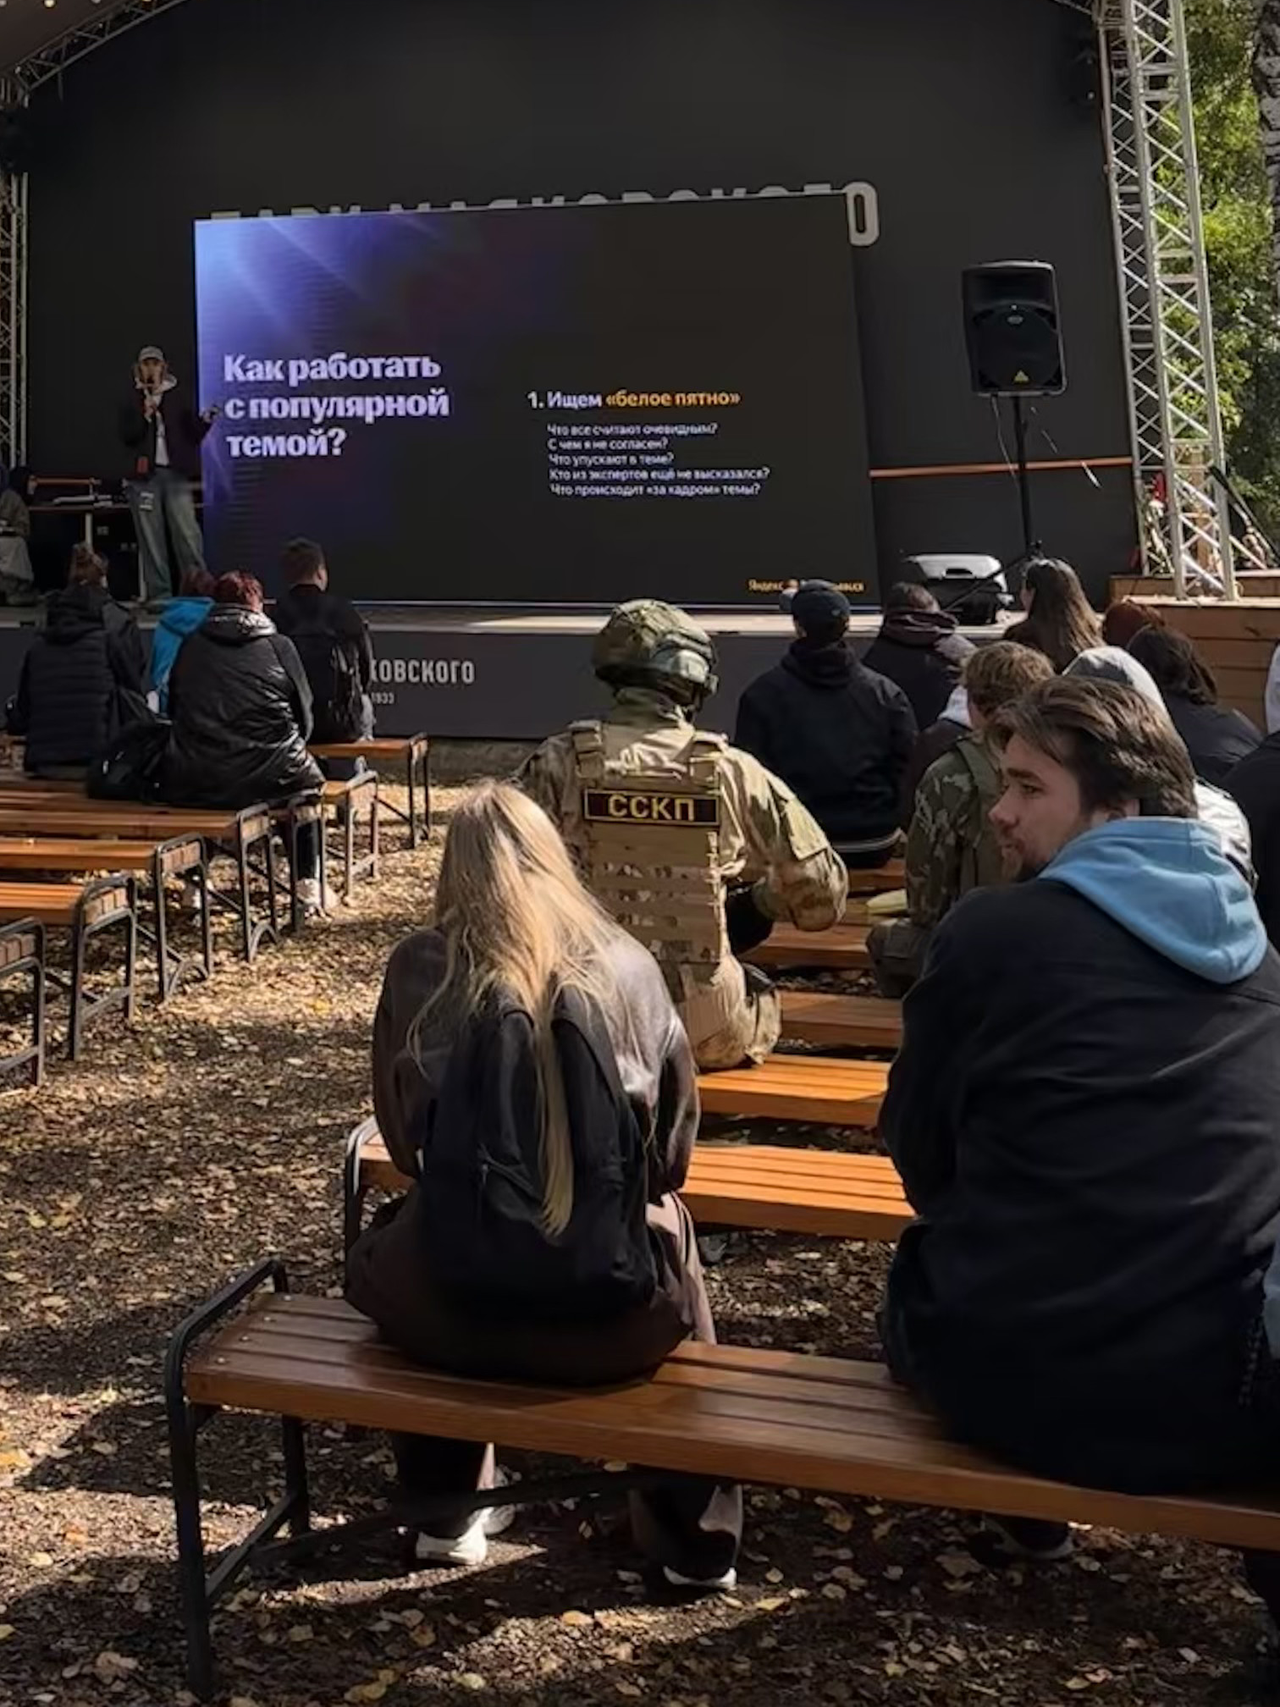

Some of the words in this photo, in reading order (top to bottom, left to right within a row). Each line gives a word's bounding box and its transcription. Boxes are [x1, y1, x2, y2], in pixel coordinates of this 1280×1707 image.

[224, 354, 284, 382] Как
[288, 352, 441, 387] работать
[225, 397, 245, 419] с
[249, 387, 450, 424] популярной
[527, 391, 544, 409] 1.
[547, 391, 602, 410] Ищем
[605, 389, 671, 407] «белое
[675, 391, 741, 407] пятно»
[547, 424, 569, 436] Что
[571, 425, 591, 436] все
[592, 425, 642, 436] считают
[643, 422, 718, 437] очевидным?
[226, 427, 347, 457] темой?
[547, 438, 558, 450] С
[559, 440, 582, 450] чем
[593, 440, 607, 450] не
[609, 436, 669, 451] согласен?
[548, 454, 571, 465] Что
[573, 455, 628, 467] упускают
[639, 452, 674, 465] теме?
[549, 468, 570, 480] Кто
[572, 469, 587, 480] из
[589, 469, 648, 482] экспертов
[677, 469, 692, 480] не
[694, 466, 770, 481] высказался?
[550, 483, 573, 495] Что
[575, 485, 644, 497] происходит
[722, 482, 761, 495] темы?
[608, 795, 695, 821] ССКП
